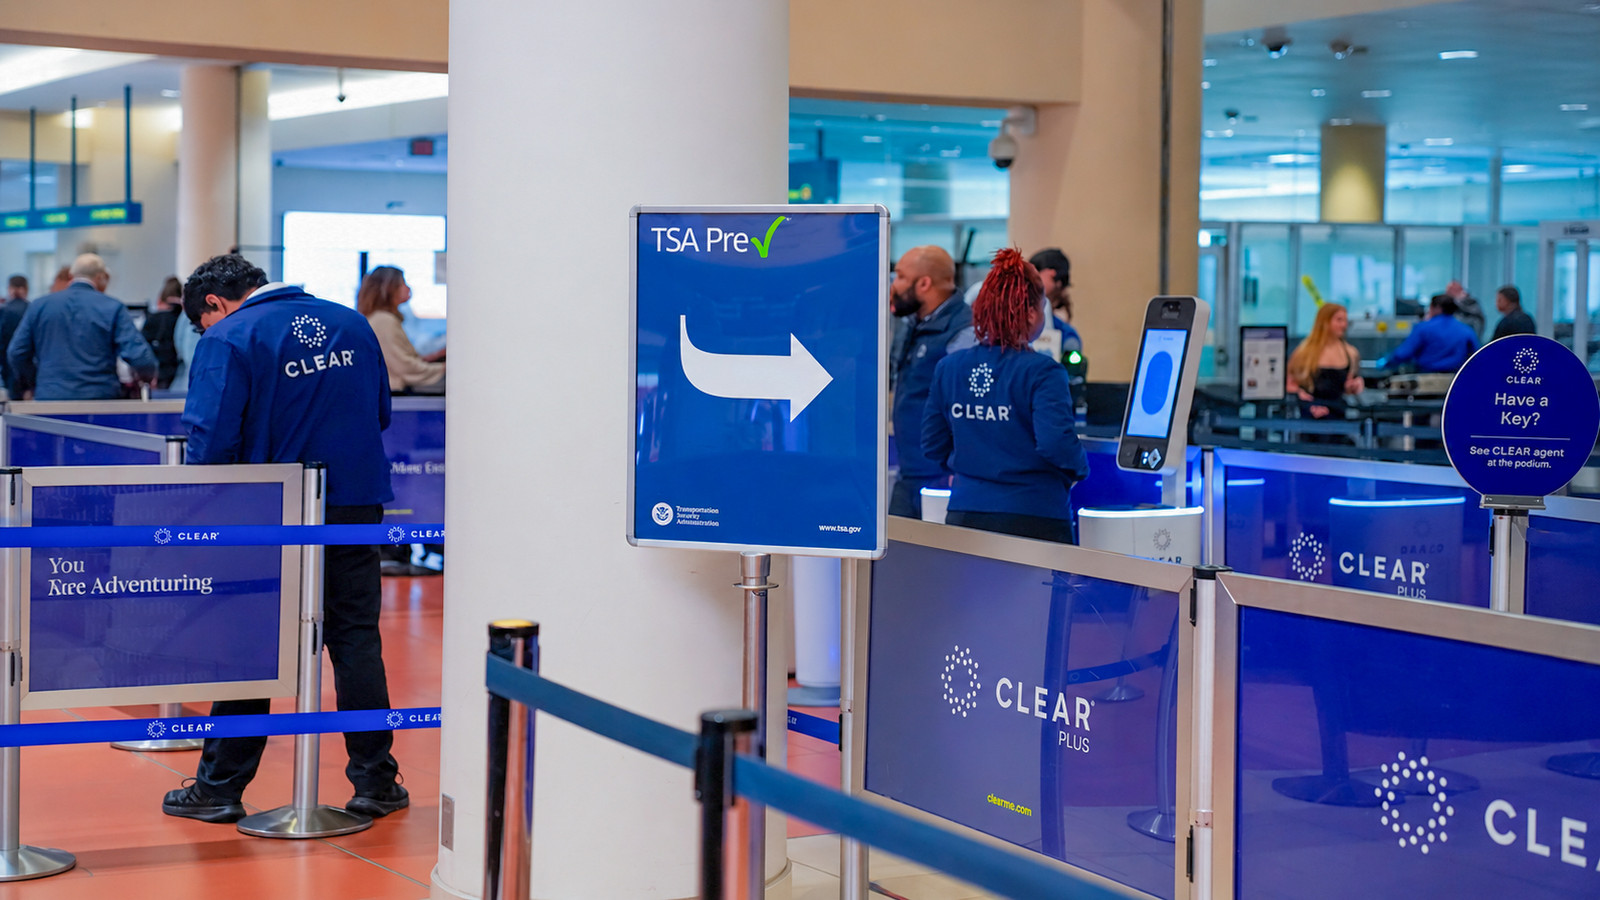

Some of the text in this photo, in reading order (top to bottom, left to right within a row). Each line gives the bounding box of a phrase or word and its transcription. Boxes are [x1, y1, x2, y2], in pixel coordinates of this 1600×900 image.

[651, 227, 749, 253] TSA Pre
[284, 350, 353, 378] CLEAR
[1506, 375, 1542, 385] CLEAR
[1494, 392, 1549, 407] Have a
[951, 403, 1010, 421] CLEAR
[1500, 411, 1541, 429] Key?
[1469, 445, 1565, 459] See CLEAR agent
[1487, 458, 1552, 469] at the podium.
[177, 532, 217, 541] CLEAR
[818, 524, 862, 534] www.tsa.gov
[48, 557, 85, 575] You
[1339, 551, 1426, 585] CLEAR
[90, 574, 213, 595] Adventuring
[1397, 585, 1427, 600] PLUS
[995, 677, 1091, 731] CLEAR
[171, 723, 212, 733] CLEAR
[1058, 730, 1090, 753] PLUS
[986, 793, 1032, 817] clearme.com
[1484, 798, 1600, 873] CLE
